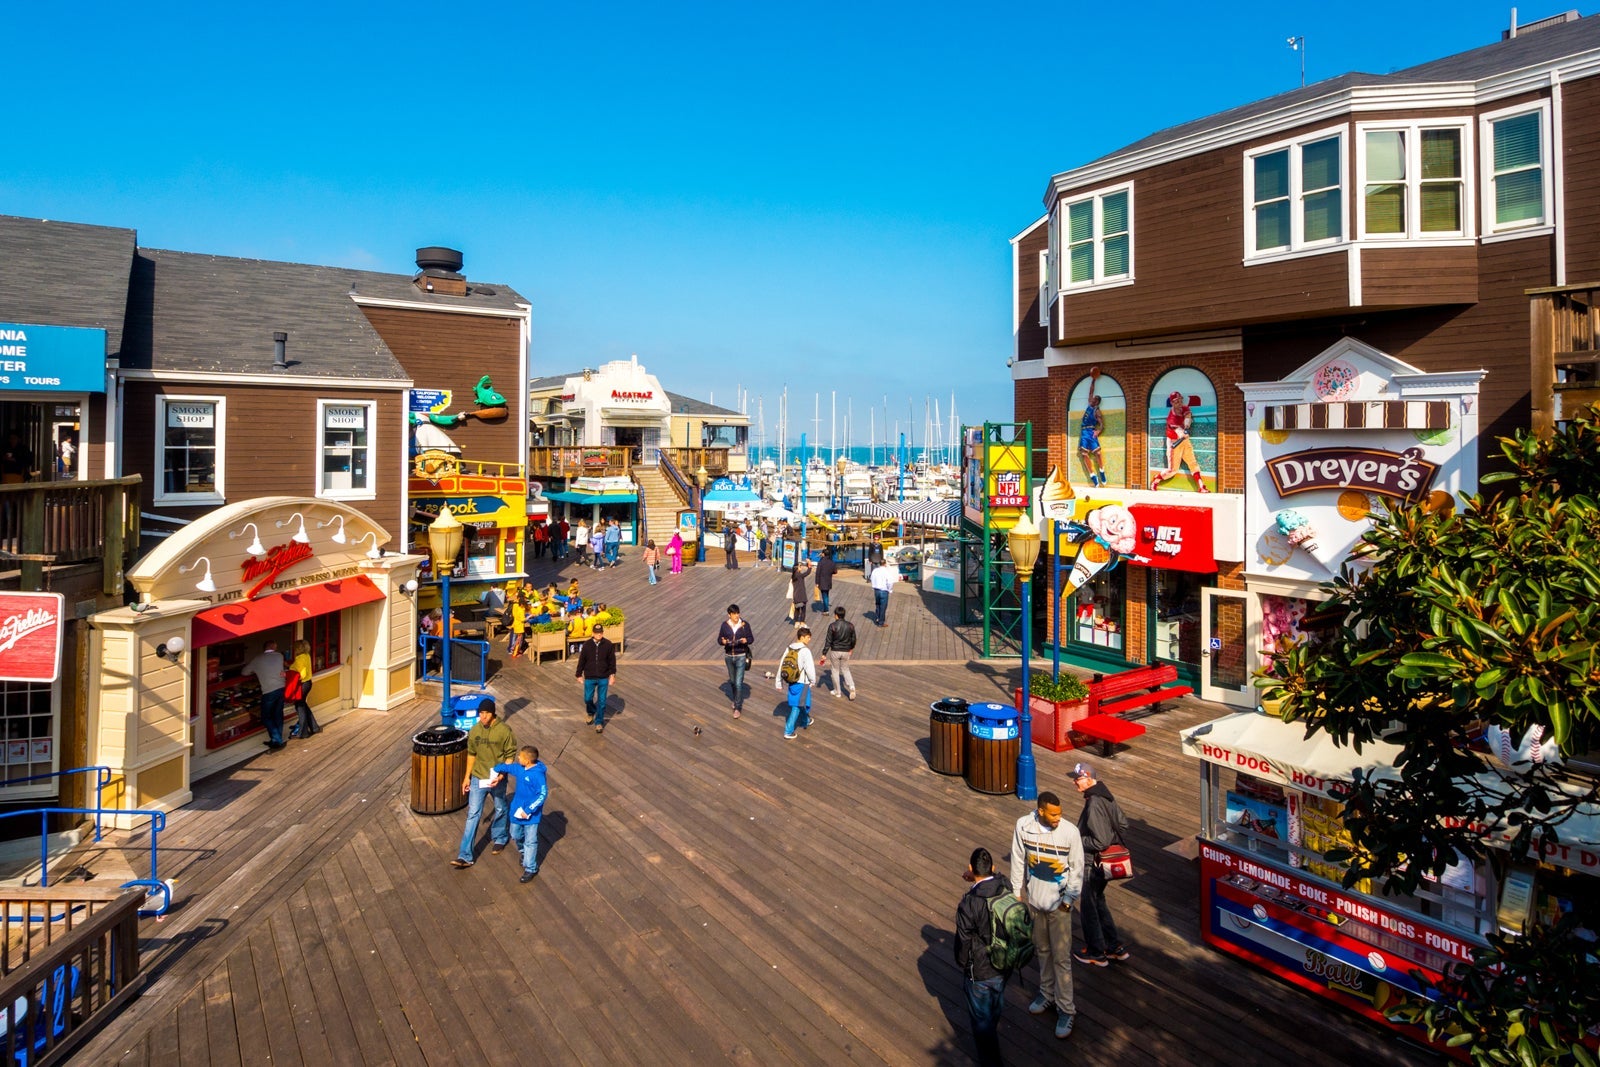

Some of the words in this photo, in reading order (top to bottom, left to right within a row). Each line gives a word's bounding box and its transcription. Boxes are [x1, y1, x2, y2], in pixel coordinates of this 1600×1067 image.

[0, 345, 26, 357] ME
[24, 376, 61, 385] TOURS
[611, 390, 653, 400] ALCATRAZ
[171, 407, 210, 415] SMOKE
[328, 408, 360, 416] SMOKE
[176, 415, 205, 423] SHOP
[1275, 453, 1420, 491] Dreyer's
[999, 482, 1019, 496] NFL
[995, 497, 1023, 505] SHOP
[1156, 525, 1183, 542] NFL
[1154, 539, 1182, 556] Shop
[217, 589, 242, 602] LATTE
[271, 578, 297, 590] COFFEE
[300, 571, 331, 584] ESPRESSO
[1202, 744, 1231, 762] HOT
[1236, 753, 1270, 774] DOG
[1292, 771, 1327, 791] HOT
[1581, 850, 1600, 868] D
[1202, 847, 1232, 867] CHIPS
[1238, 860, 1291, 890] LEMONADE
[1298, 883, 1328, 905] COKE
[1336, 897, 1378, 925] POLISH
[1380, 914, 1415, 939] DOGS
[1425, 931, 1460, 956] FOOT
[1303, 949, 1363, 990] Ball
